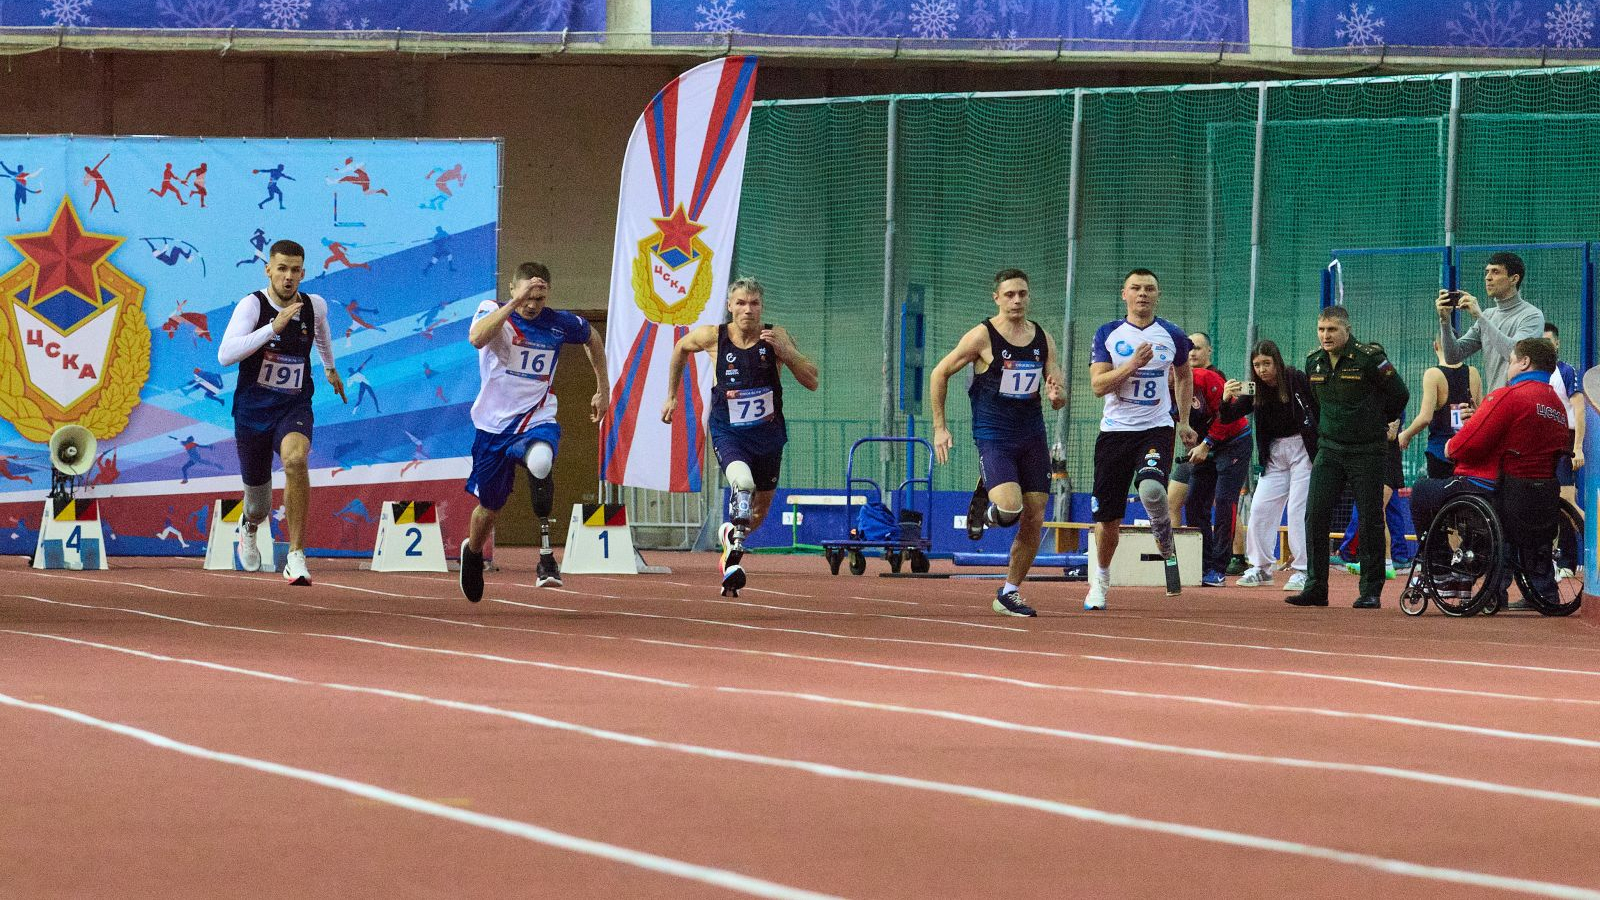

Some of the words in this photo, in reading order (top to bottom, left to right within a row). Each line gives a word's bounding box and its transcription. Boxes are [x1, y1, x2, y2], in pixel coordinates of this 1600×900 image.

[654, 265, 686, 294] ЦСКА
[27, 330, 97, 379] ЦСКА
[520, 350, 546, 373] 16
[264, 363, 300, 387] 191
[1013, 372, 1037, 391] 17
[1131, 380, 1156, 398] 18
[737, 399, 765, 419] 73
[1452, 411, 1460, 425] 1
[65, 525, 82, 554] 4
[405, 527, 423, 557] 2
[598, 530, 609, 559] 1
